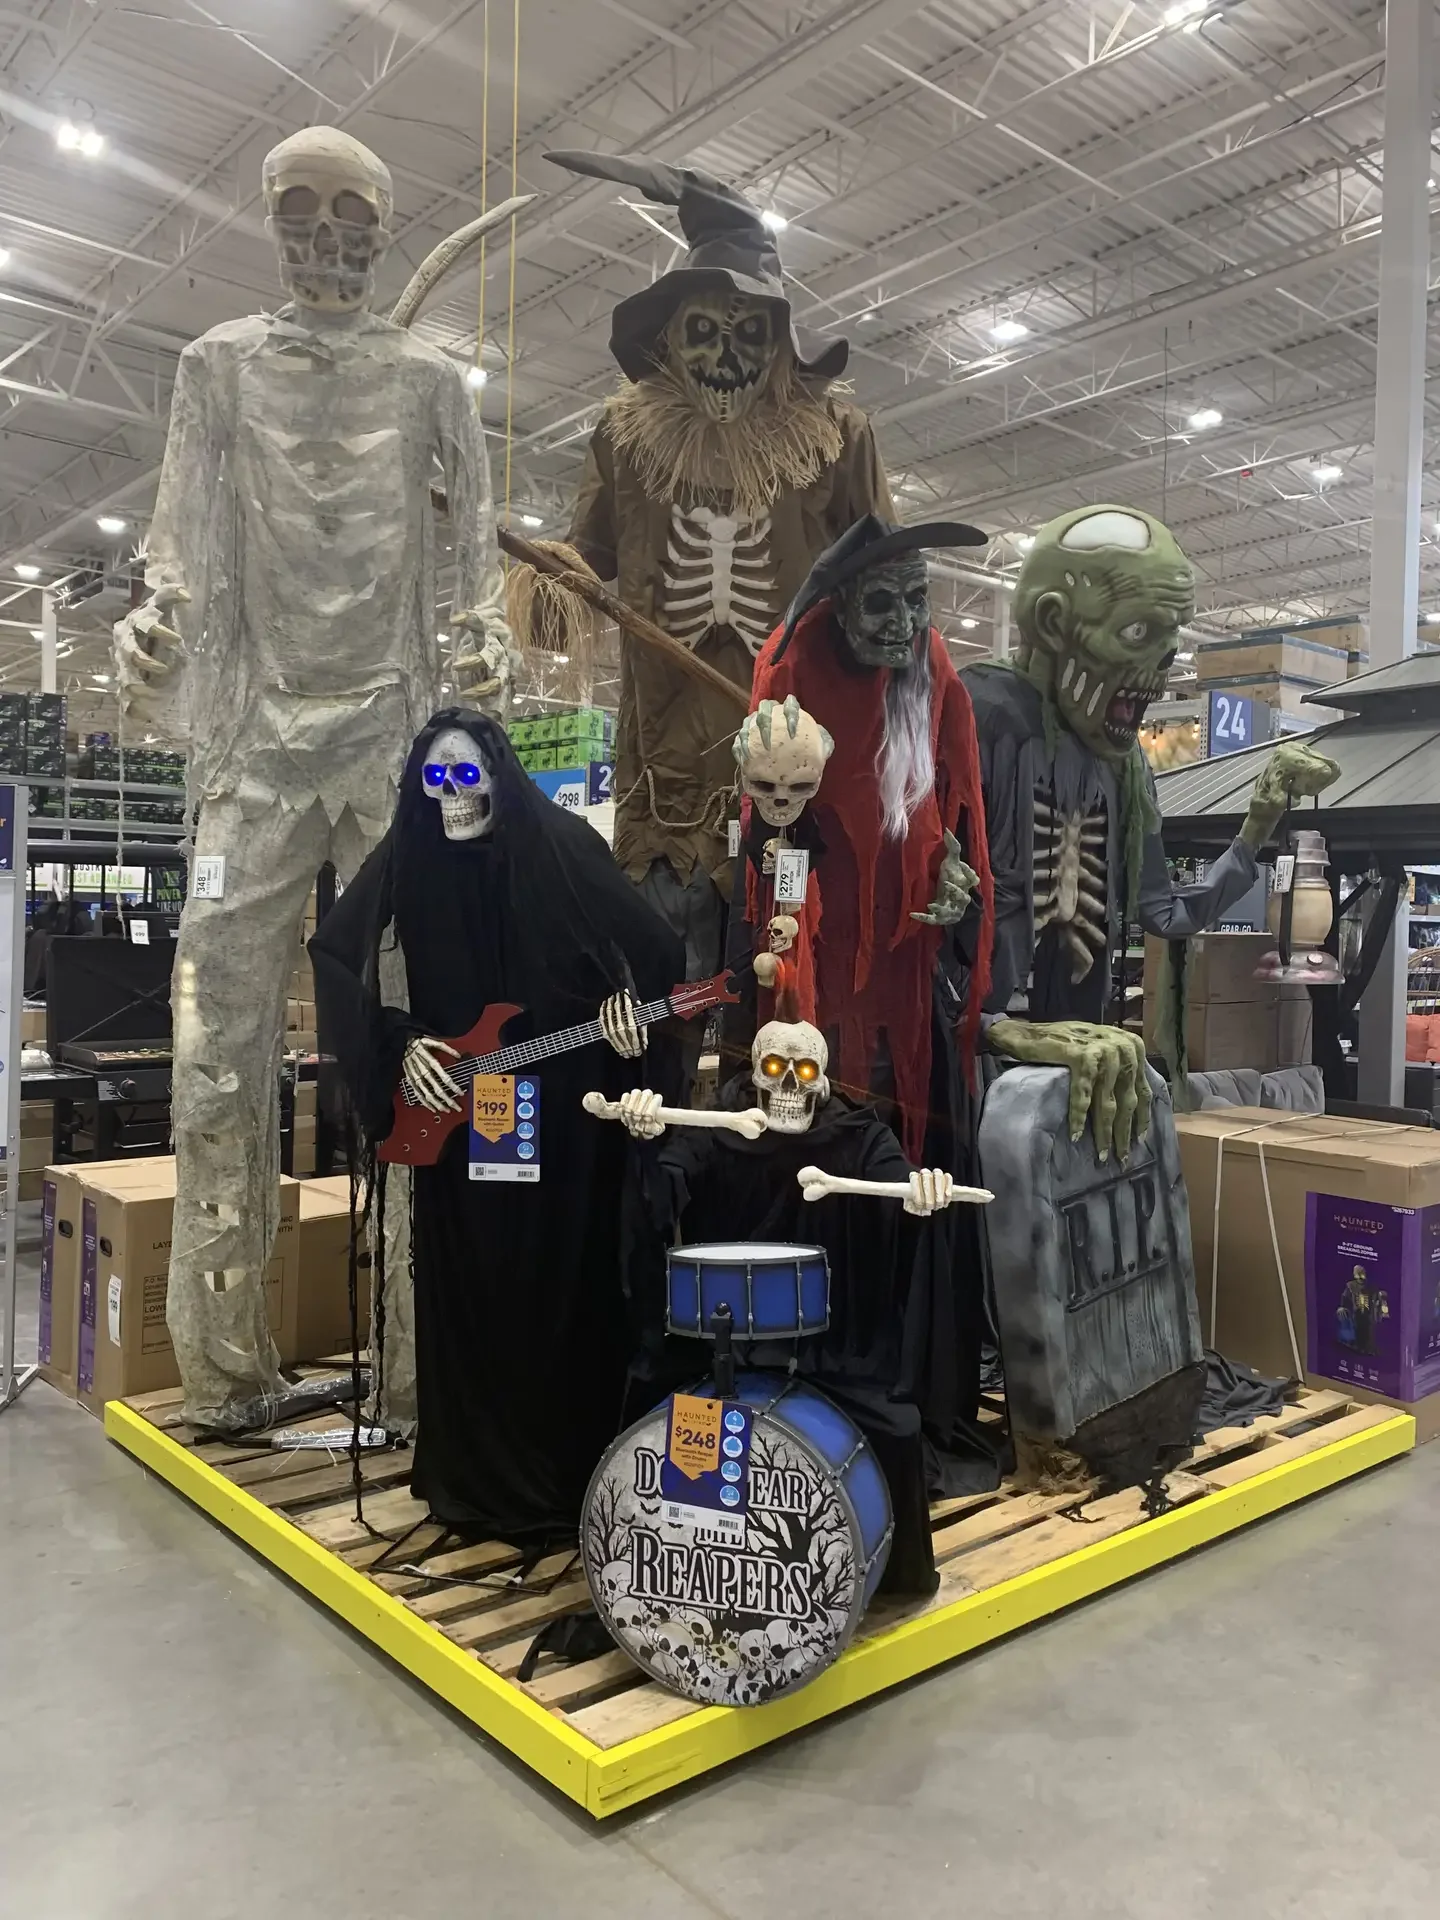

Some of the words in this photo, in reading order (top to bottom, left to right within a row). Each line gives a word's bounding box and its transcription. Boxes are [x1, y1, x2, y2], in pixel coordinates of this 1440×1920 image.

[1216, 696, 1246, 741] 24
[599, 765, 614, 791] 2
[558, 793, 579, 807] $298
[779, 873, 789, 896] $279
[476, 1100, 508, 1116] $199
[1333, 1214, 1384, 1230] HAUNTED
[1062, 1172, 1163, 1302] R.I.P.
[677, 1410, 717, 1423] HAUNTED
[675, 1425, 716, 1449] $248
[629, 1526, 813, 1621] REAPERS
